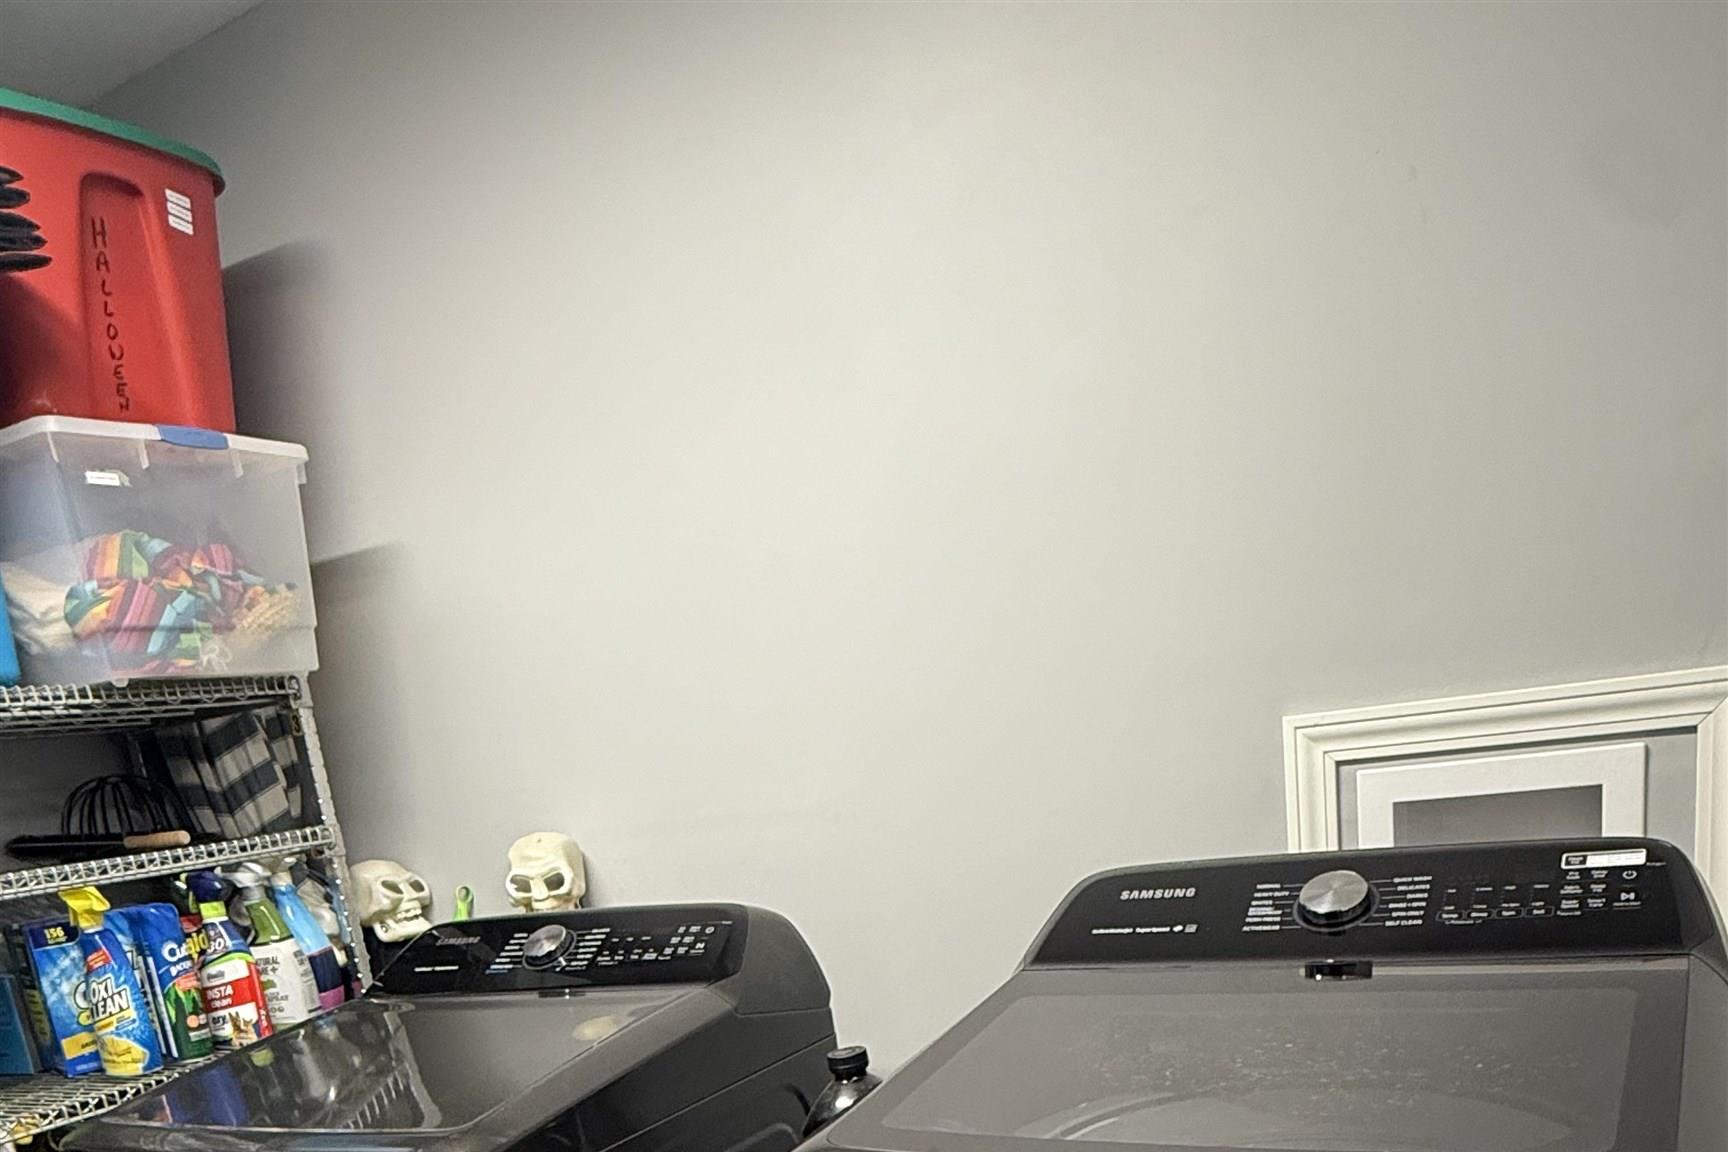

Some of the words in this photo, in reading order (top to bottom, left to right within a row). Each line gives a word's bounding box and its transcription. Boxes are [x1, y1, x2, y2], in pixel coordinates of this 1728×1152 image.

[91, 216, 130, 412] HALLOWEEN
[1120, 887, 1196, 900] SAMSUNG
[43, 926, 66, 940] 156
[90, 977, 114, 1005] OXI
